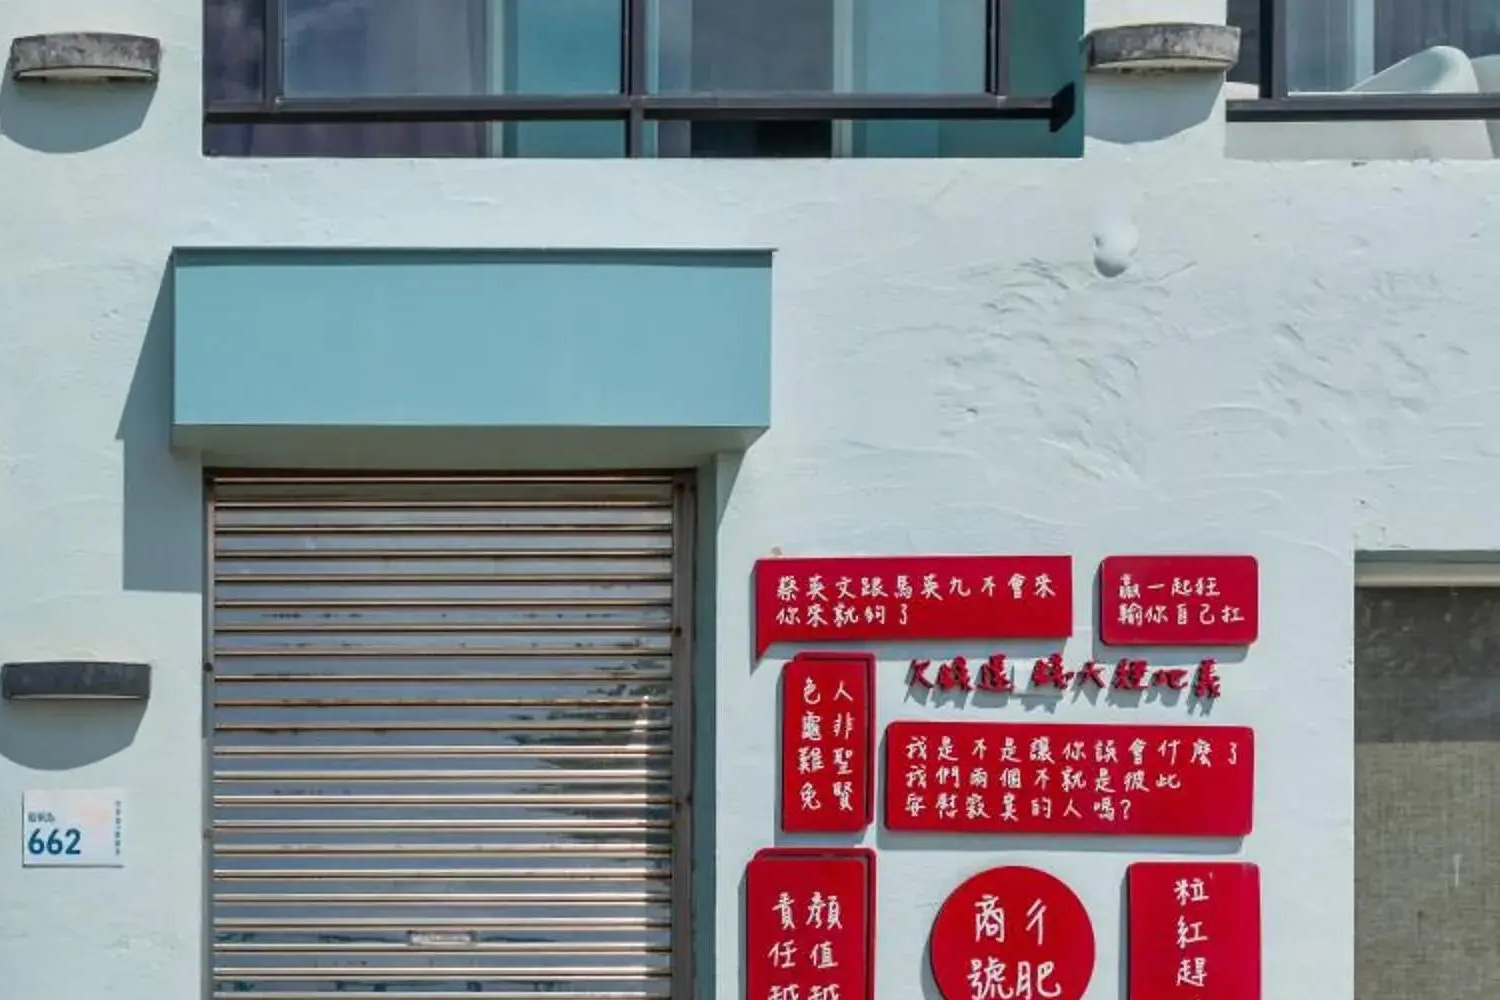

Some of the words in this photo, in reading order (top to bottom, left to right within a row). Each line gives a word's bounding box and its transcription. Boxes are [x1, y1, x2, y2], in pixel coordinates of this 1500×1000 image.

[777, 573, 1055, 602] 蔡英文跟馬英九不會來
[1119, 573, 1221, 599] 贏一起狂
[775, 602, 908, 628] 你來就夠了
[1117, 601, 1245, 626] 輸你自己扛
[832, 681, 853, 811] 人非聖賢
[905, 764, 1181, 793] 我們兩個不就是彼此
[28, 828, 81, 855] 662
